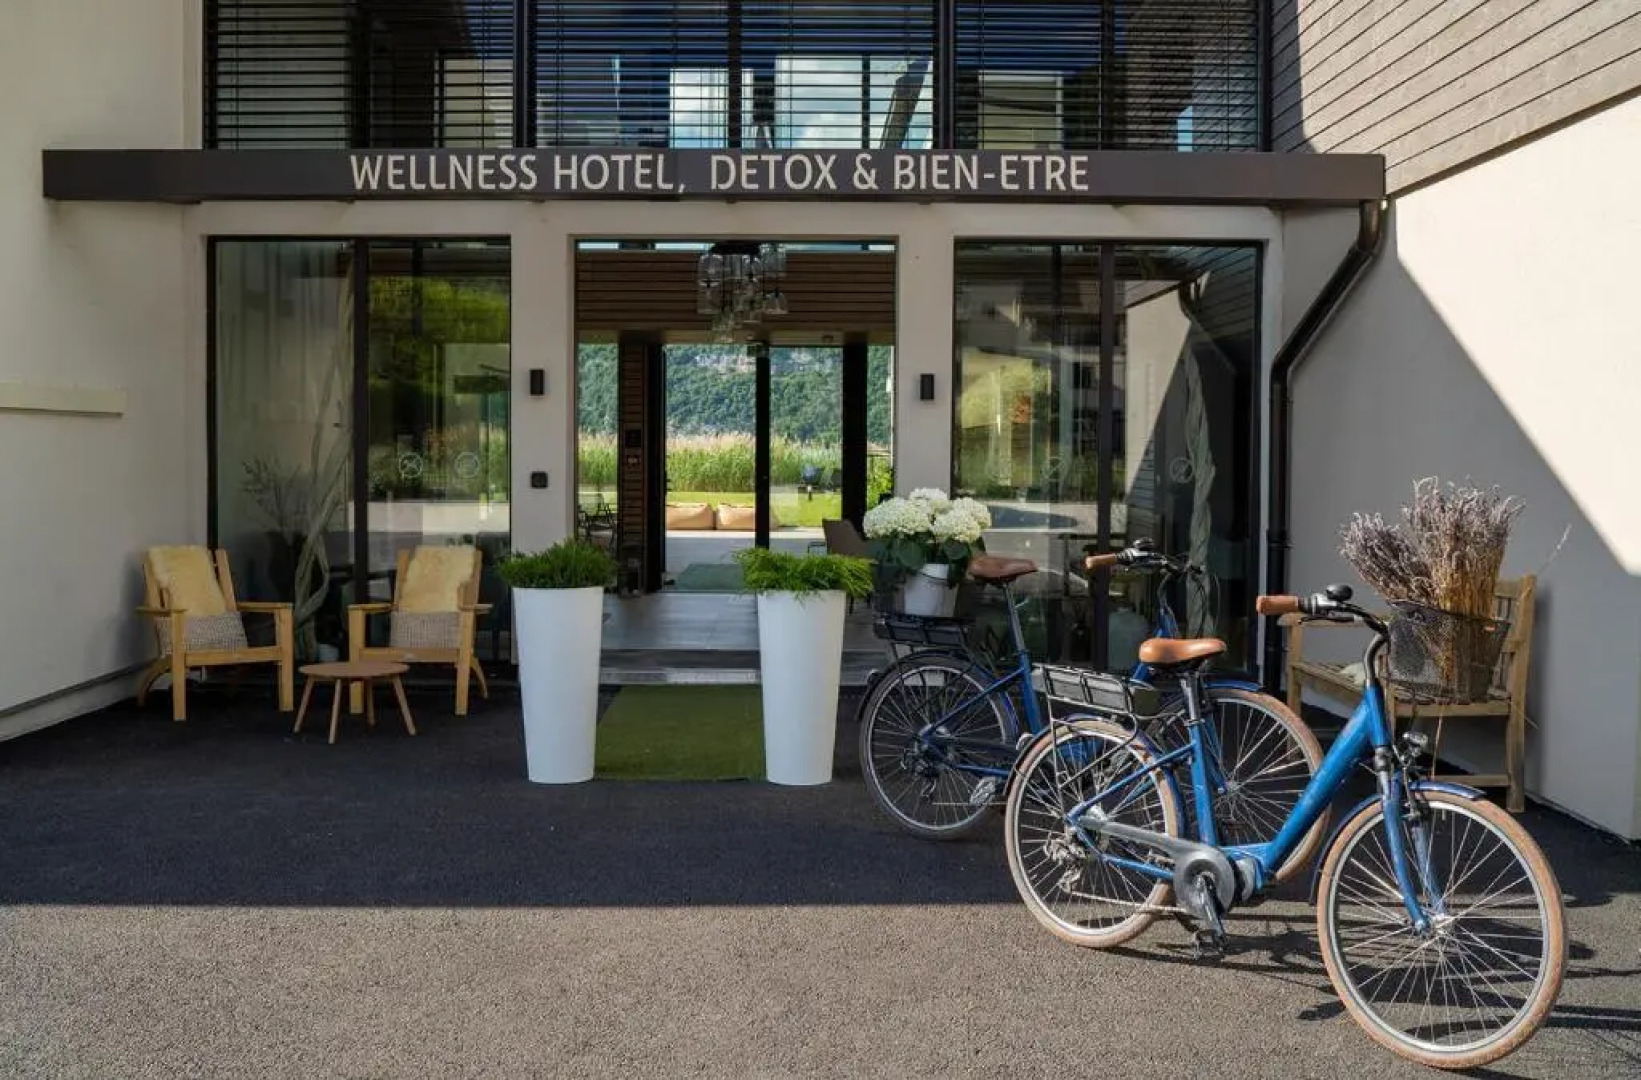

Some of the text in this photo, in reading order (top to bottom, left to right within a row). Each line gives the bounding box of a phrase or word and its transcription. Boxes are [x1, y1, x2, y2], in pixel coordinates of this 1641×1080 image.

[350, 152, 1089, 193] WELLNESS HOTEL, DETOX & BIEN-ETRE
